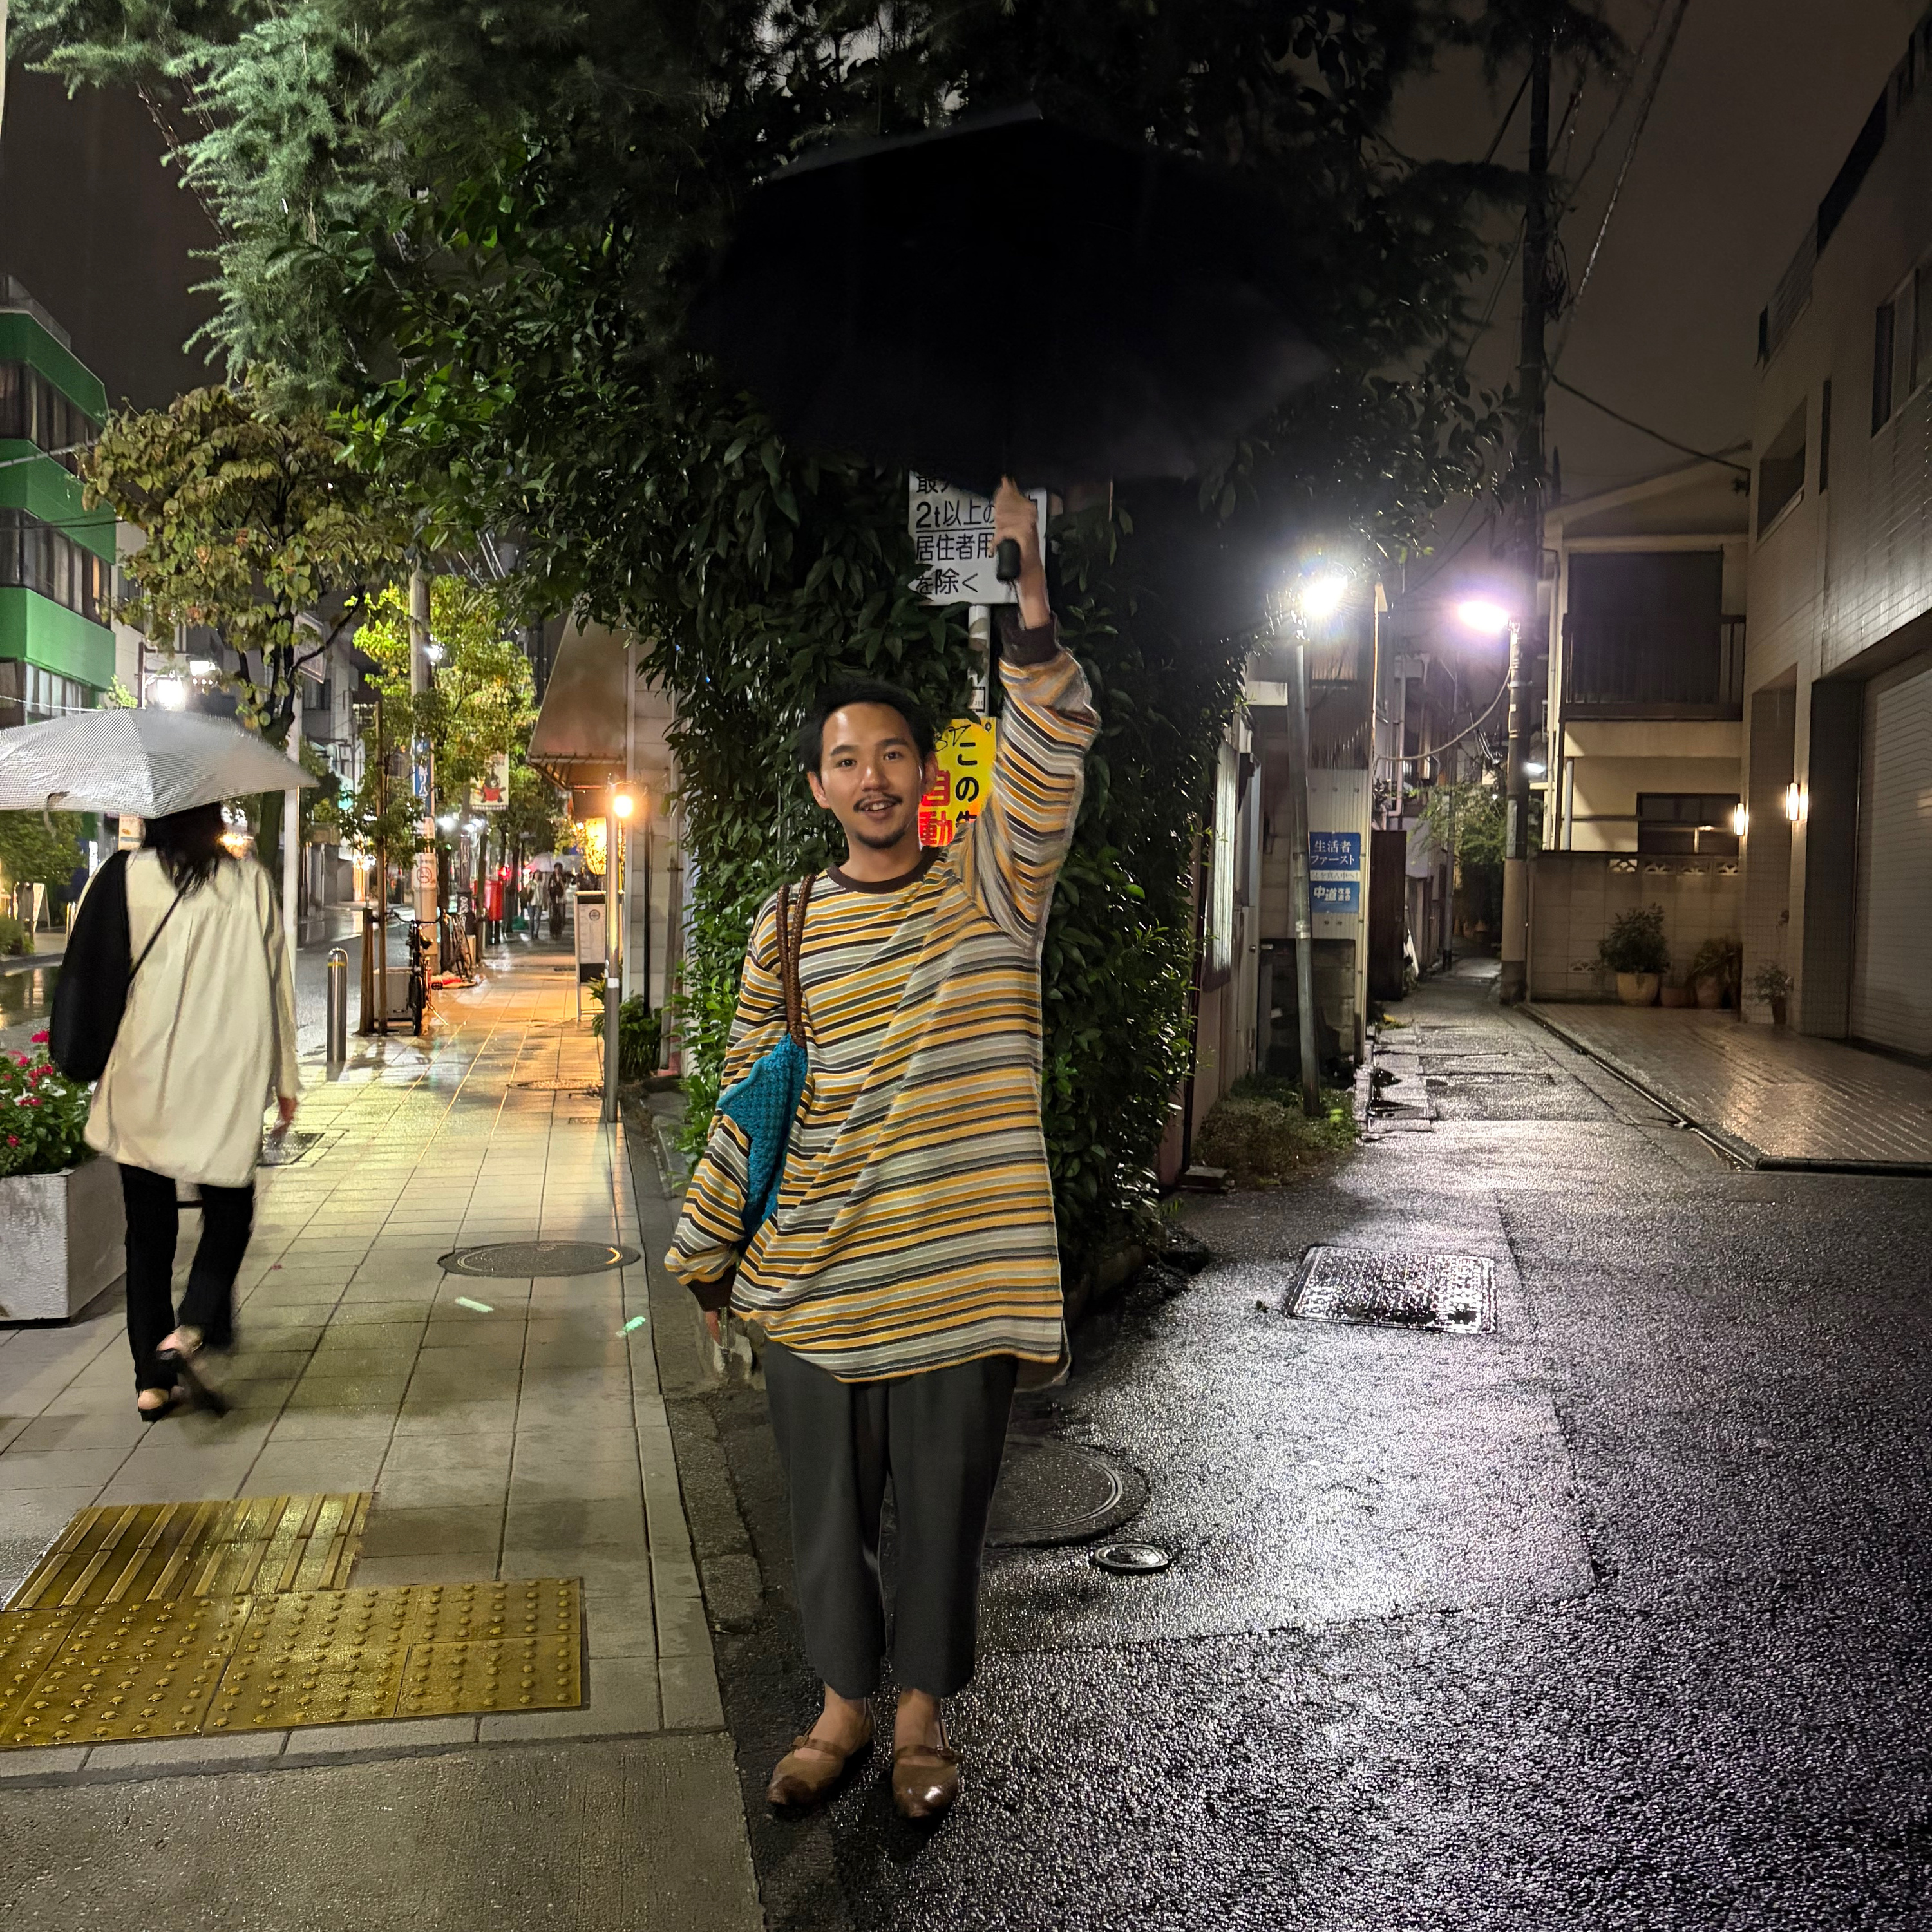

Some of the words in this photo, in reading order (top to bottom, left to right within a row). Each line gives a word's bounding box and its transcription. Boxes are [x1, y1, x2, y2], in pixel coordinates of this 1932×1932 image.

[916, 567, 978, 596] を除く
[1314, 840, 1351, 853] 生活者
[1311, 855, 1355, 866] ファースト
[1314, 886, 1337, 902] 中道
